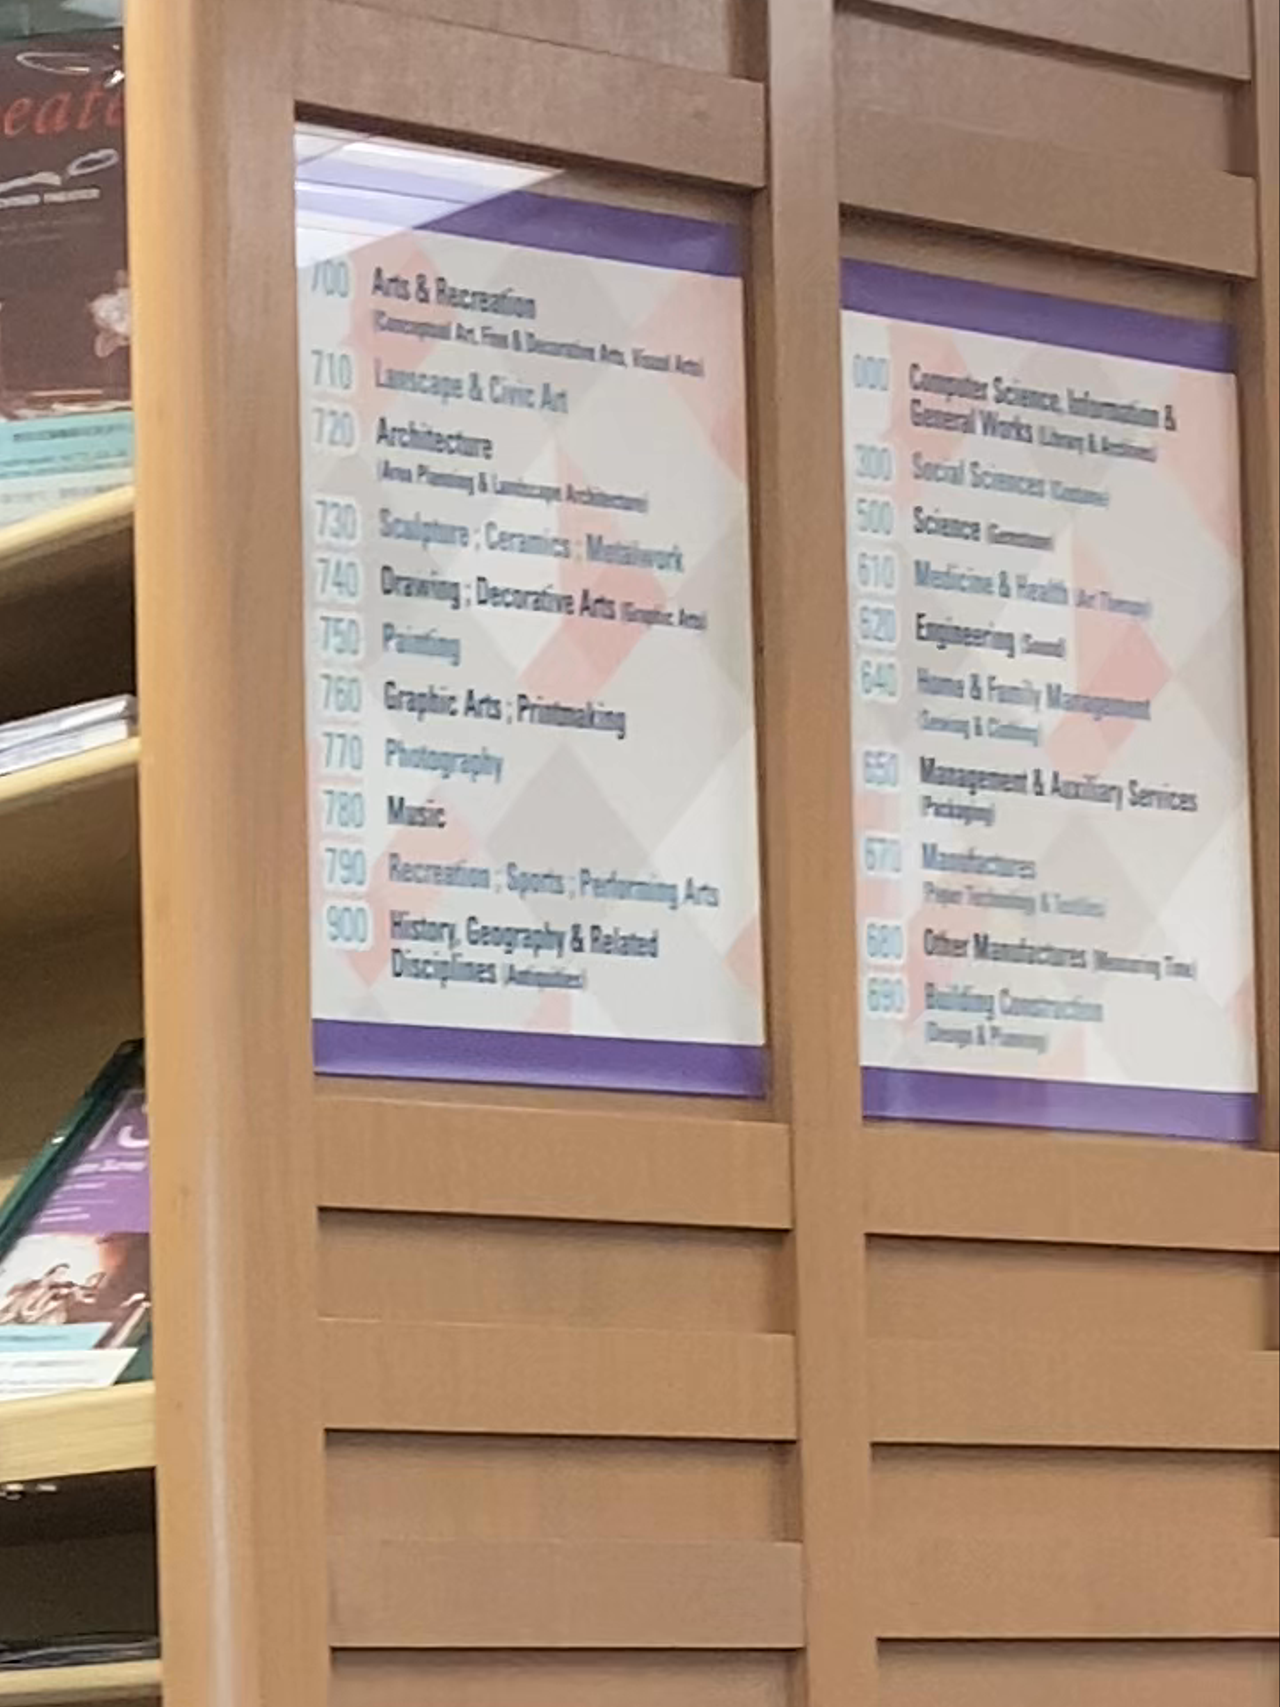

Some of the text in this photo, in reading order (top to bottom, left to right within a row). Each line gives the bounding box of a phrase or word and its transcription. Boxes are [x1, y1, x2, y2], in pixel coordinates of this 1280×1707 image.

[372, 267, 410, 303] Arts
[415, 273, 430, 304] &
[436, 277, 536, 319] Recreation
[312, 350, 352, 389] 710
[470, 373, 483, 402] &
[489, 375, 534, 408] Civic
[541, 382, 568, 413] Art
[909, 363, 989, 402] Computer
[1067, 388, 1159, 428] Information
[313, 408, 493, 459] 720 Architecture
[910, 399, 975, 434] General
[980, 410, 1033, 444] Works
[912, 452, 964, 486] Social
[970, 461, 1045, 498] Sciences
[316, 500, 683, 572] 730 Sculpture Ceramics Metalwork
[913, 505, 981, 542] Science
[318, 558, 358, 597] 740
[381, 565, 460, 609] Drawing
[476, 576, 574, 615] Decorative
[579, 590, 615, 620] Arts
[914, 559, 993, 594] Medicine
[320, 616, 461, 666] 750 Painting
[916, 612, 1015, 658] Engineering
[321, 674, 626, 739] 760 Graphic Arts Printmaking
[1047, 683, 1151, 721] Management
[323, 733, 503, 783] 770 Photography
[921, 756, 1028, 795] Management
[1033, 768, 1045, 796] &
[1051, 771, 1122, 810] Auxiliary
[1129, 780, 1198, 812] Services
[324, 791, 447, 829] 780 Music
[326, 848, 719, 910] 790 Recreation Sports Performing Arts
[922, 843, 1036, 879] Manufactures
[327, 906, 368, 943] 900
[466, 916, 565, 958] Geography
[571, 925, 585, 953] &
[590, 926, 659, 958] Related
[924, 928, 969, 958] Other
[973, 933, 1087, 969] Manufactures
[391, 949, 497, 988] Disciplines
[925, 982, 995, 1022] Building
